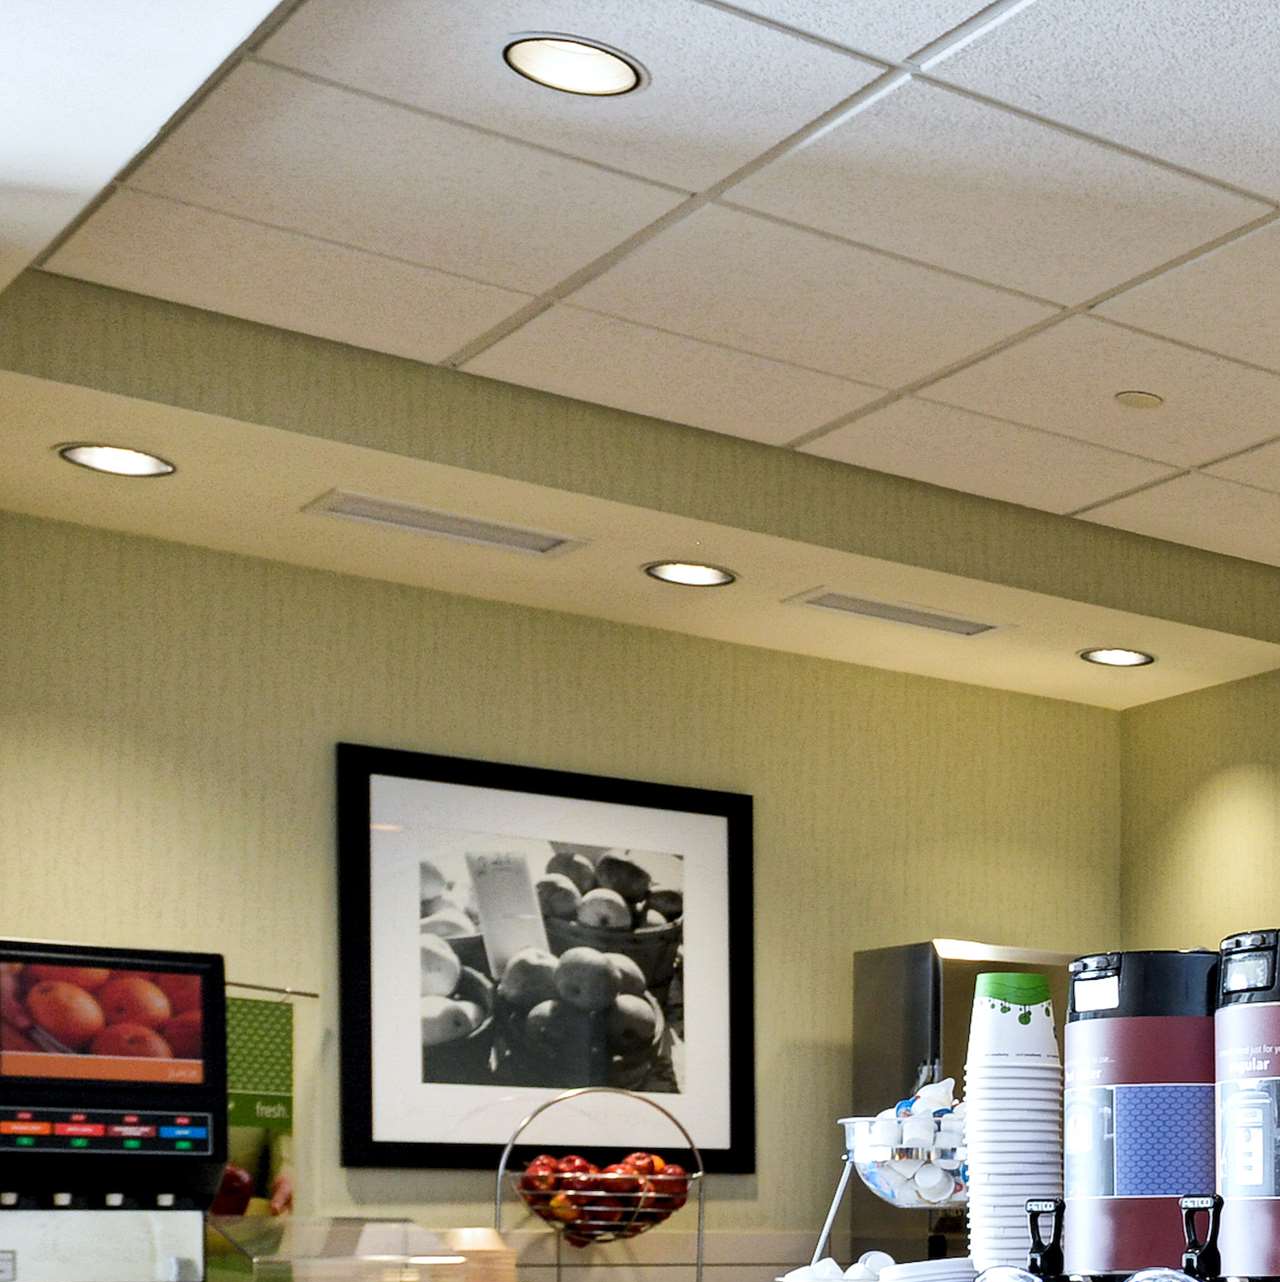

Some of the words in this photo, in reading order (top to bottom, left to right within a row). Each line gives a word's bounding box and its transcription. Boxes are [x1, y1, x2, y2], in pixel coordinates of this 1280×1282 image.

[1263, 1044, 1273, 1053] for
[1027, 1201, 1055, 1211] FETCO
[1182, 1198, 1212, 1208] FETCO
